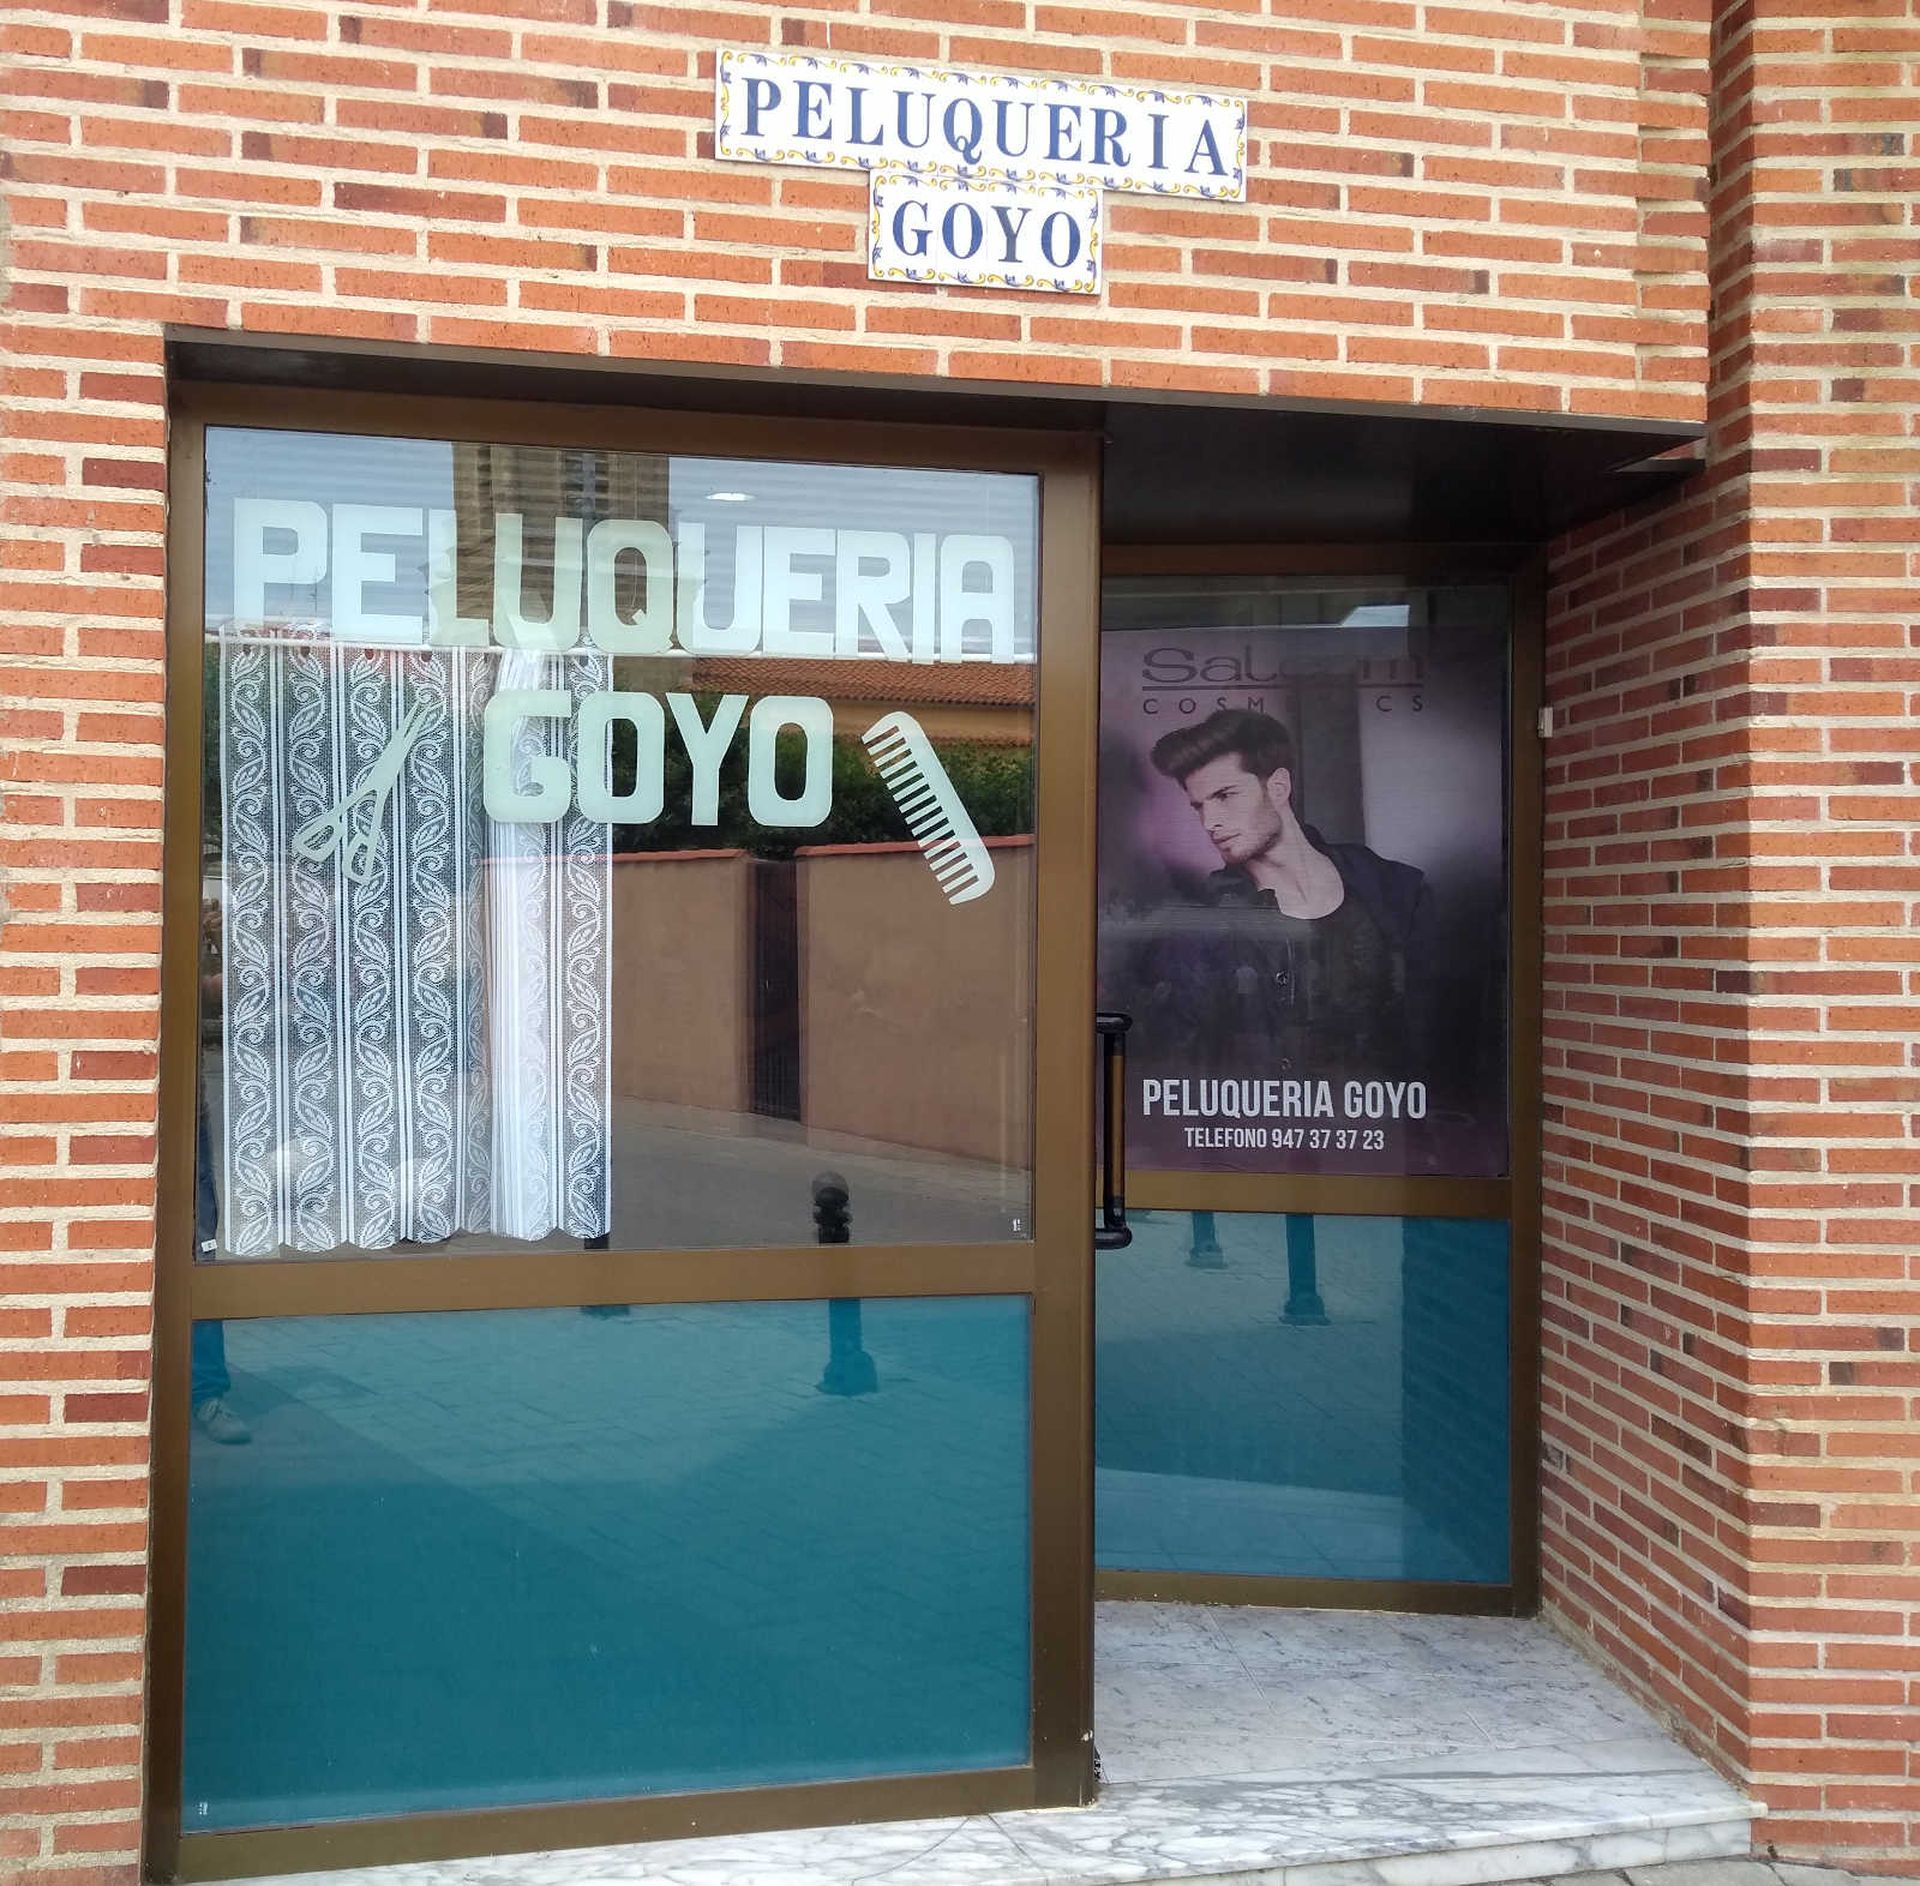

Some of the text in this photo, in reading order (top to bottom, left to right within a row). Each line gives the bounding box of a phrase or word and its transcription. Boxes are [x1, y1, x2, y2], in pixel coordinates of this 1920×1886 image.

[741, 77, 1228, 176] PELUQUERIA
[892, 199, 1081, 268] GOYO
[233, 498, 1015, 664] PELUQUERIA
[484, 689, 834, 828] GOYO
[1142, 1079, 1427, 1119] PELUQUERIA GOYO
[1184, 1127, 1385, 1150] TELEFONO 947 37 37 23
